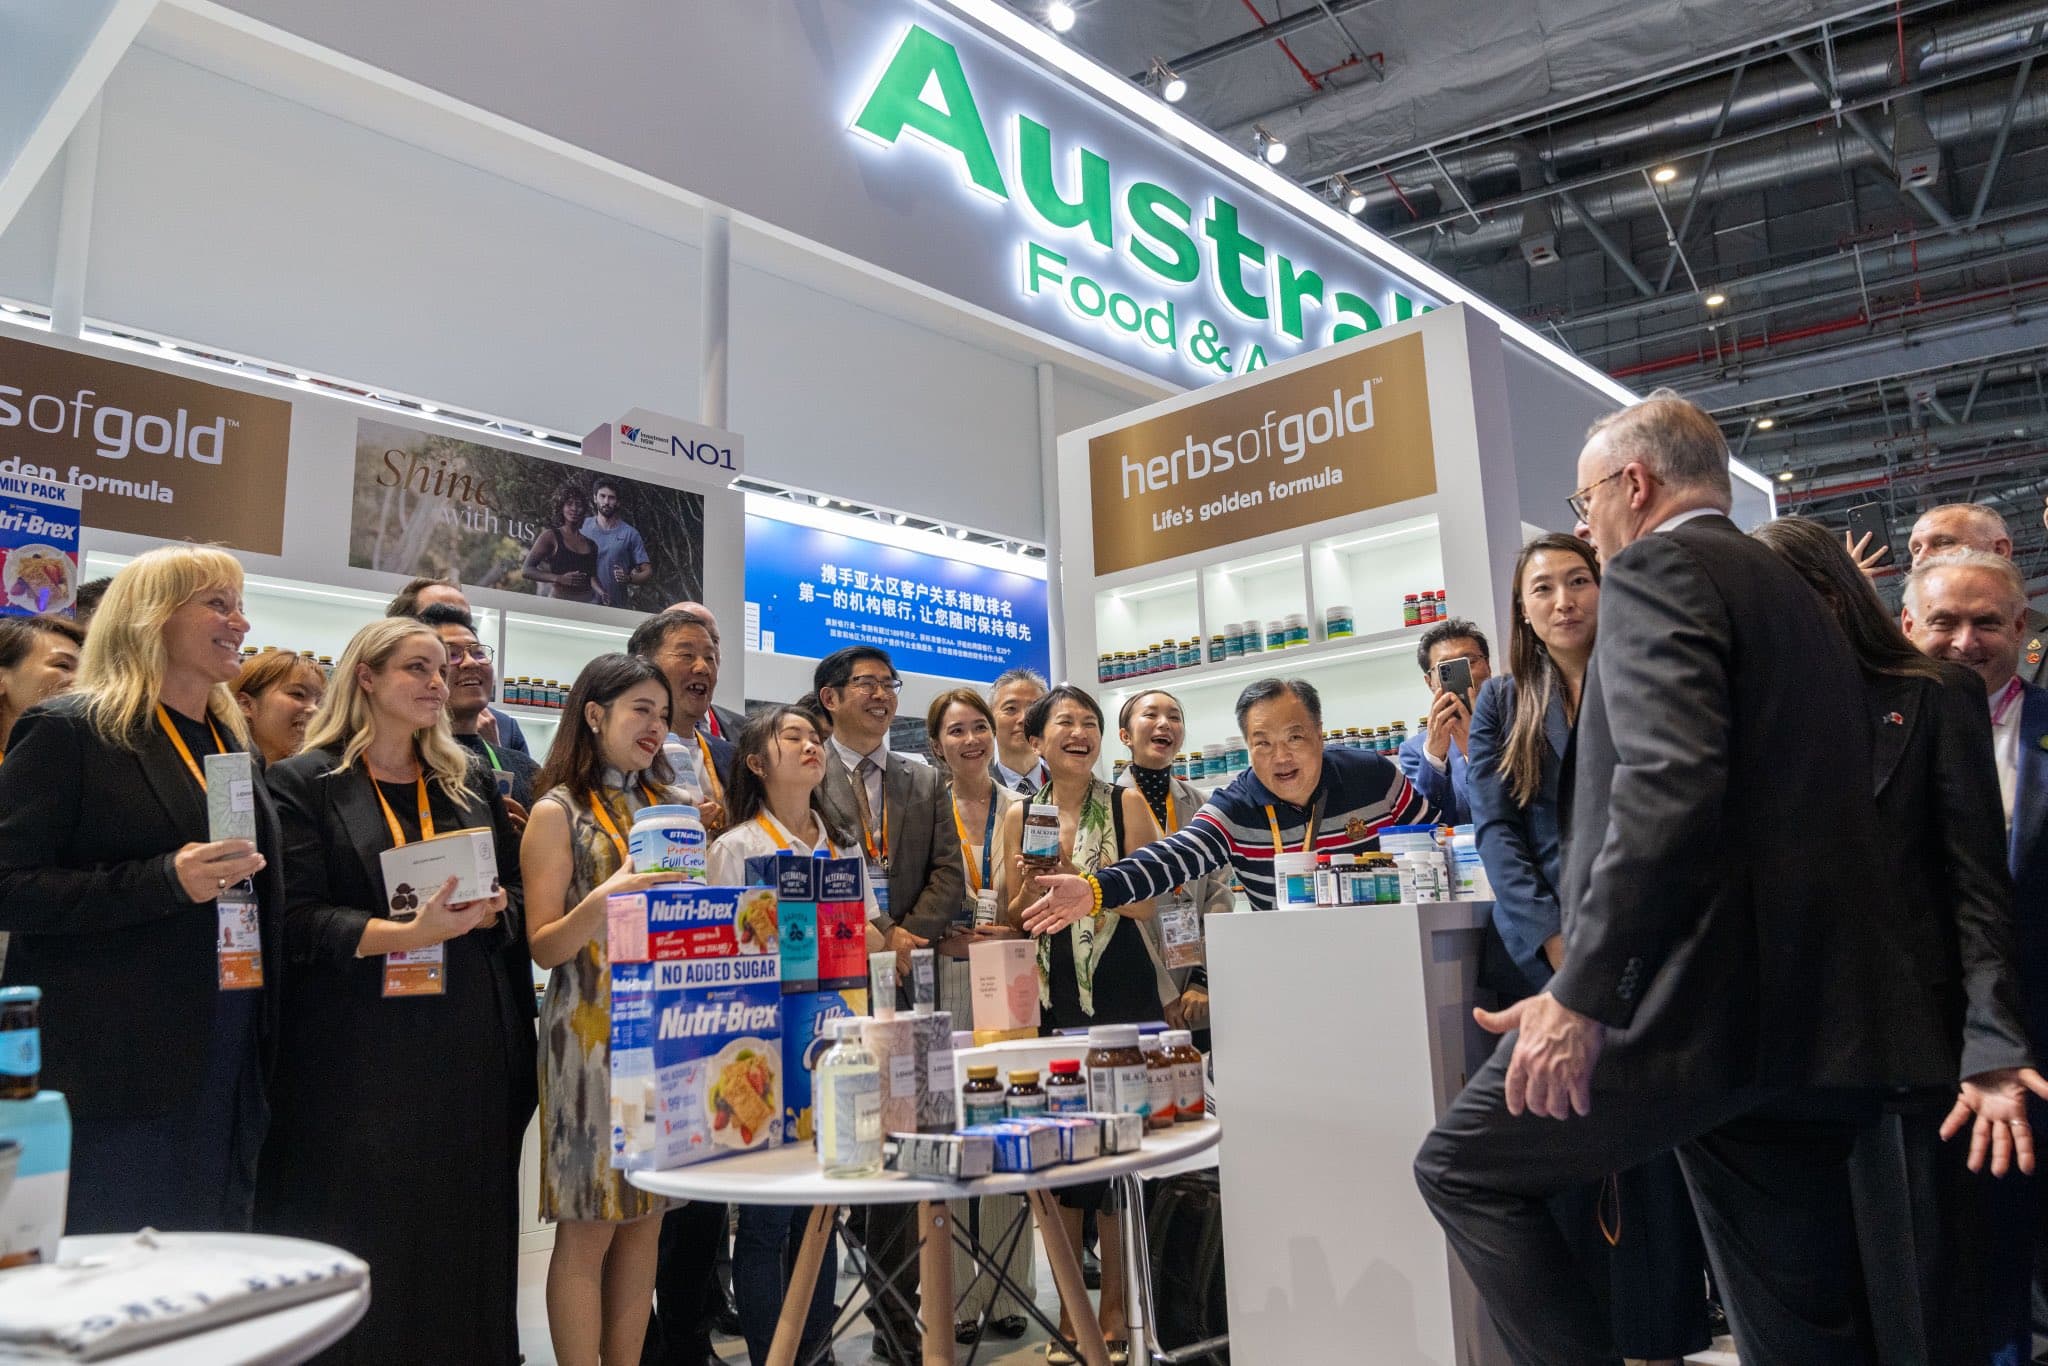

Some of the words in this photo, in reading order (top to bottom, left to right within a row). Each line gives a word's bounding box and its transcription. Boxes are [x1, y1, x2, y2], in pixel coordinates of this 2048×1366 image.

[850, 22, 1442, 343] Austra
[1022, 242, 1178, 353] Food
[1190, 320, 1233, 374] &
[671, 435, 737, 471] NO1
[0, 456, 57, 484] den
[68, 466, 174, 504] formula
[0, 476, 28, 495] MILY
[31, 482, 66, 501] PACK
[375, 447, 499, 508] Shine
[1152, 506, 1194, 532] Life's
[1199, 489, 1263, 521] golden
[1268, 466, 1343, 502] formula
[0, 509, 77, 541] tri-Brex
[441, 507, 501, 534] with
[508, 518, 538, 542] us
[820, 563, 1013, 618] 携手亚太区客户关系指数排名
[662, 856, 681, 869] Full
[825, 872, 856, 885] ALTERNATIVE
[651, 899, 735, 922] Nutri-Brex
[661, 965, 682, 985] NO
[685, 962, 731, 983] ADDED
[733, 959, 776, 979] SUGAR
[658, 1000, 778, 1041] Nutri-Brex
